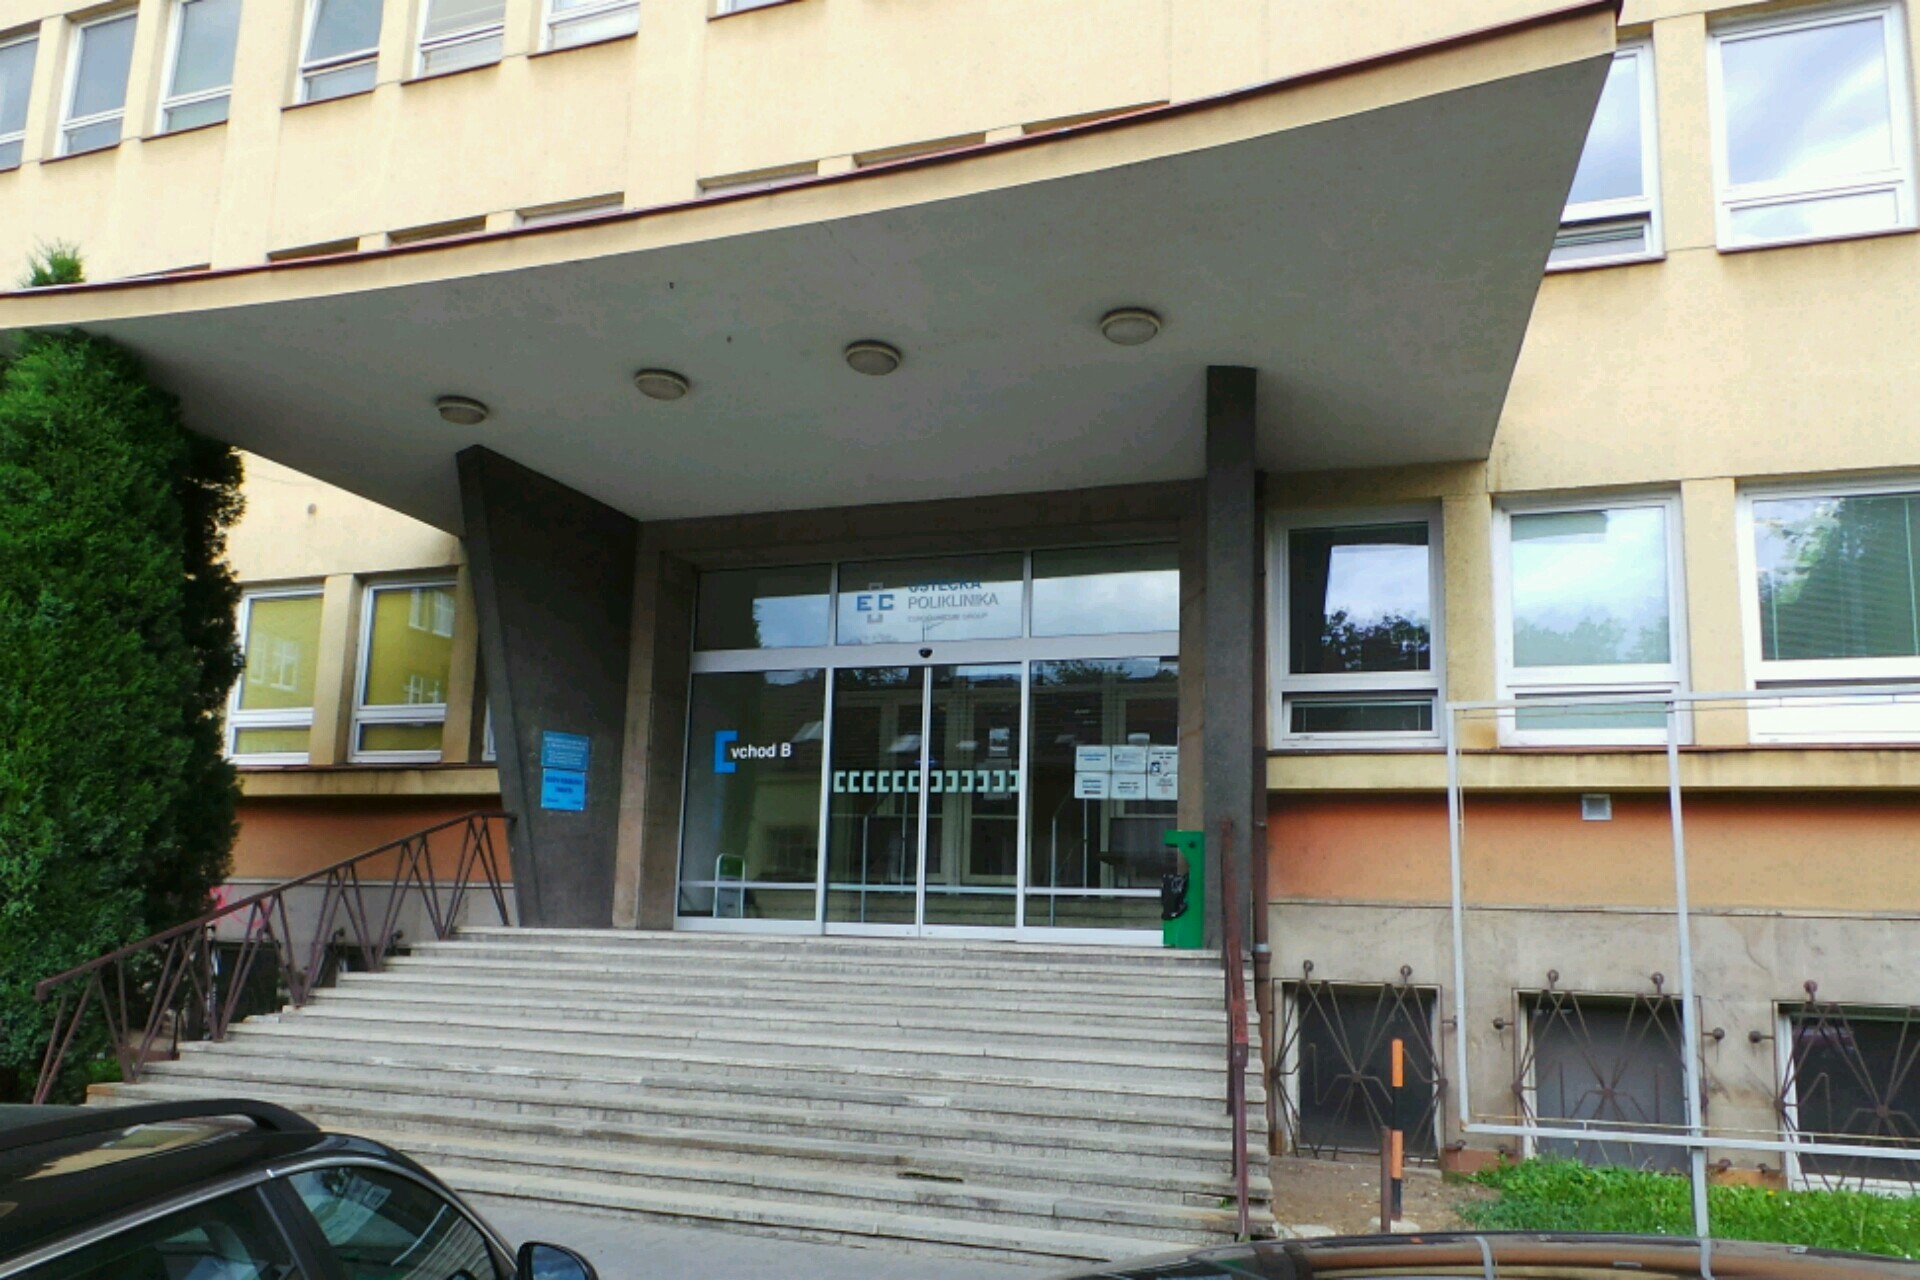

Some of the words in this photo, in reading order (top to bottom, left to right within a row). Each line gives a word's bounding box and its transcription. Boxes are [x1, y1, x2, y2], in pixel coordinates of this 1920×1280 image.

[907, 592, 999, 609] POLIKLINIKA
[731, 742, 777, 759] vchod
[780, 741, 792, 758] B
